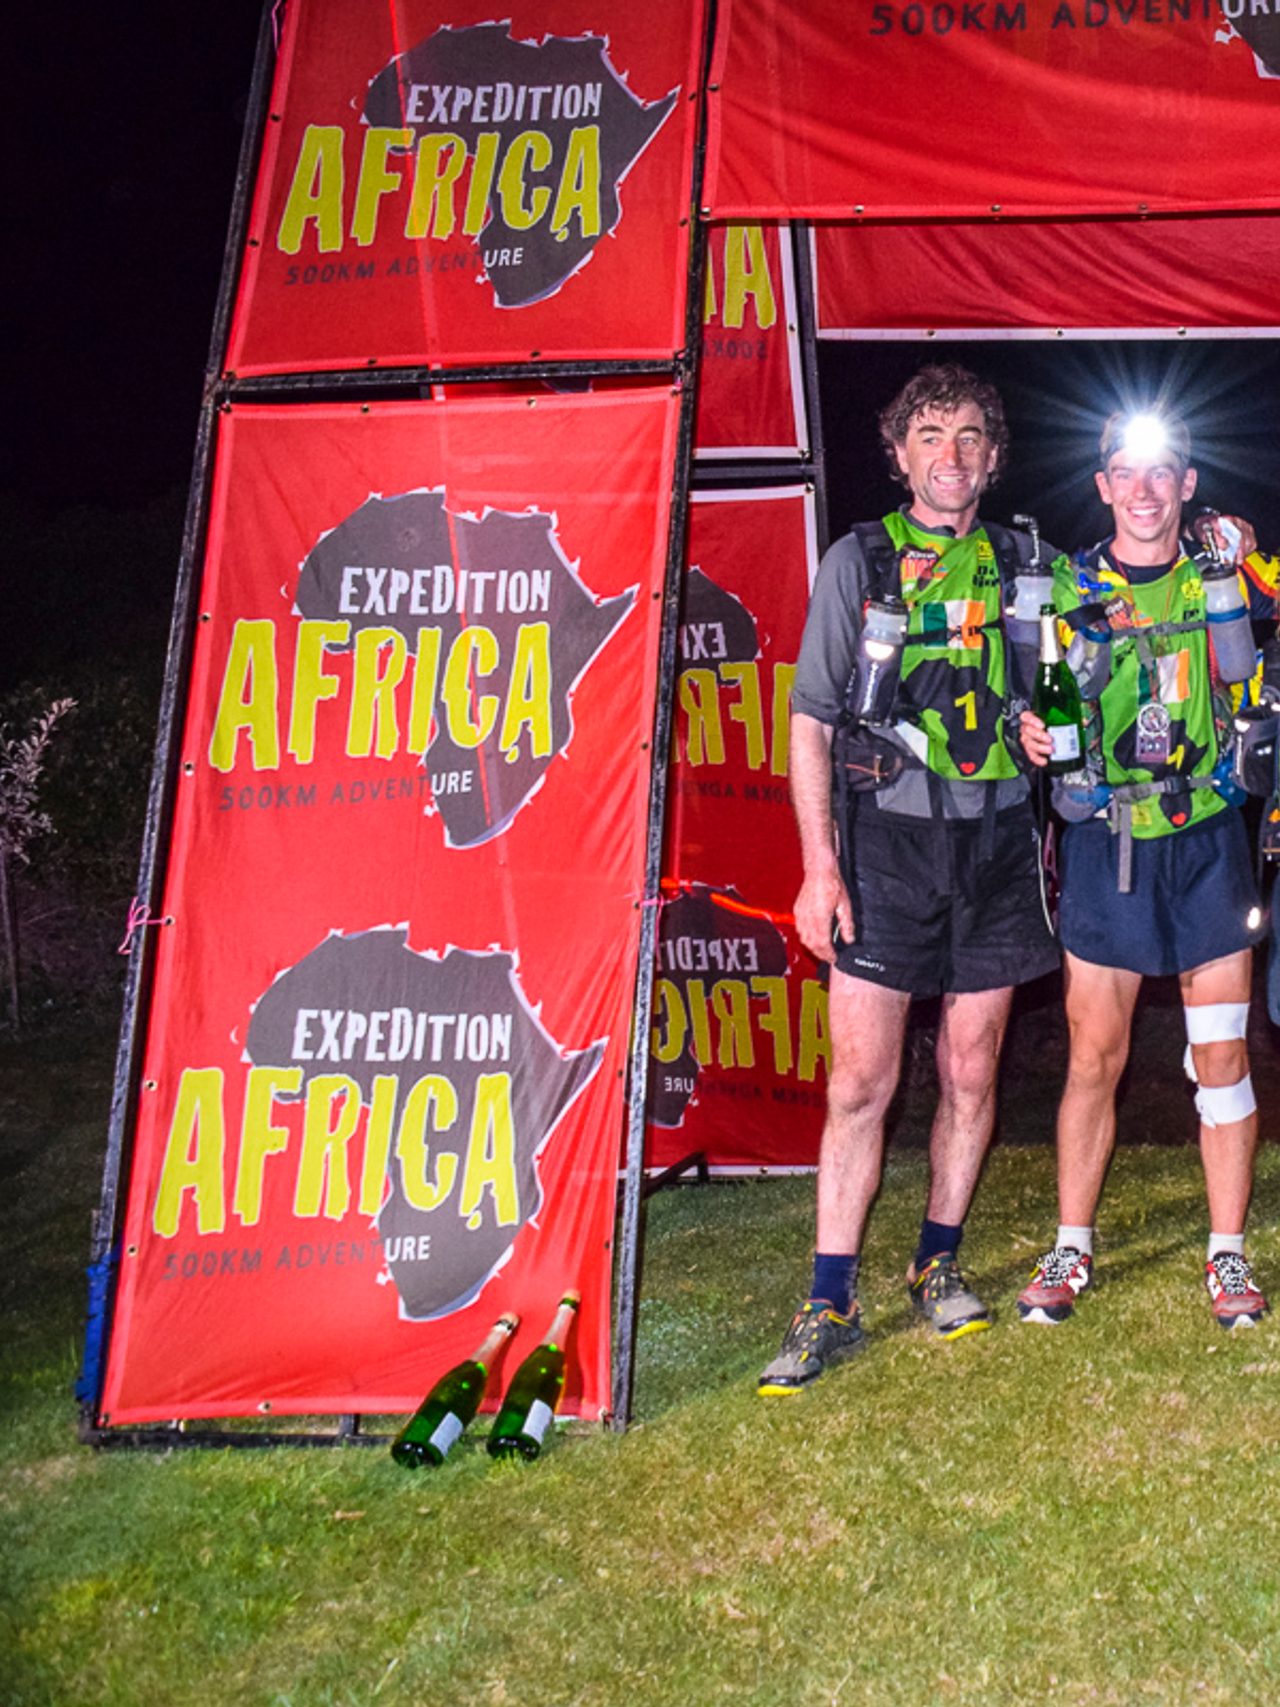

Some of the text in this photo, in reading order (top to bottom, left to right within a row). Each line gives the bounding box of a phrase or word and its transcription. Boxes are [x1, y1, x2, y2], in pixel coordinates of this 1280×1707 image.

[870, 2, 1027, 36] 500KM
[405, 81, 602, 124] EXPEDITION
[276, 124, 602, 255] AFRICA
[285, 246, 524, 286] 500KM ADVENTURE
[339, 564, 552, 616] EXPEDITION
[208, 618, 553, 773] AFRICA
[955, 691, 977, 731] 1
[1166, 744, 1185, 770] 1
[218, 770, 473, 812] 500KM ADVENTURE
[292, 1006, 512, 1061] EXPEDITION
[152, 1067, 520, 1238] AFRICA
[163, 1235, 431, 1281] 500KM ADVENTURE
